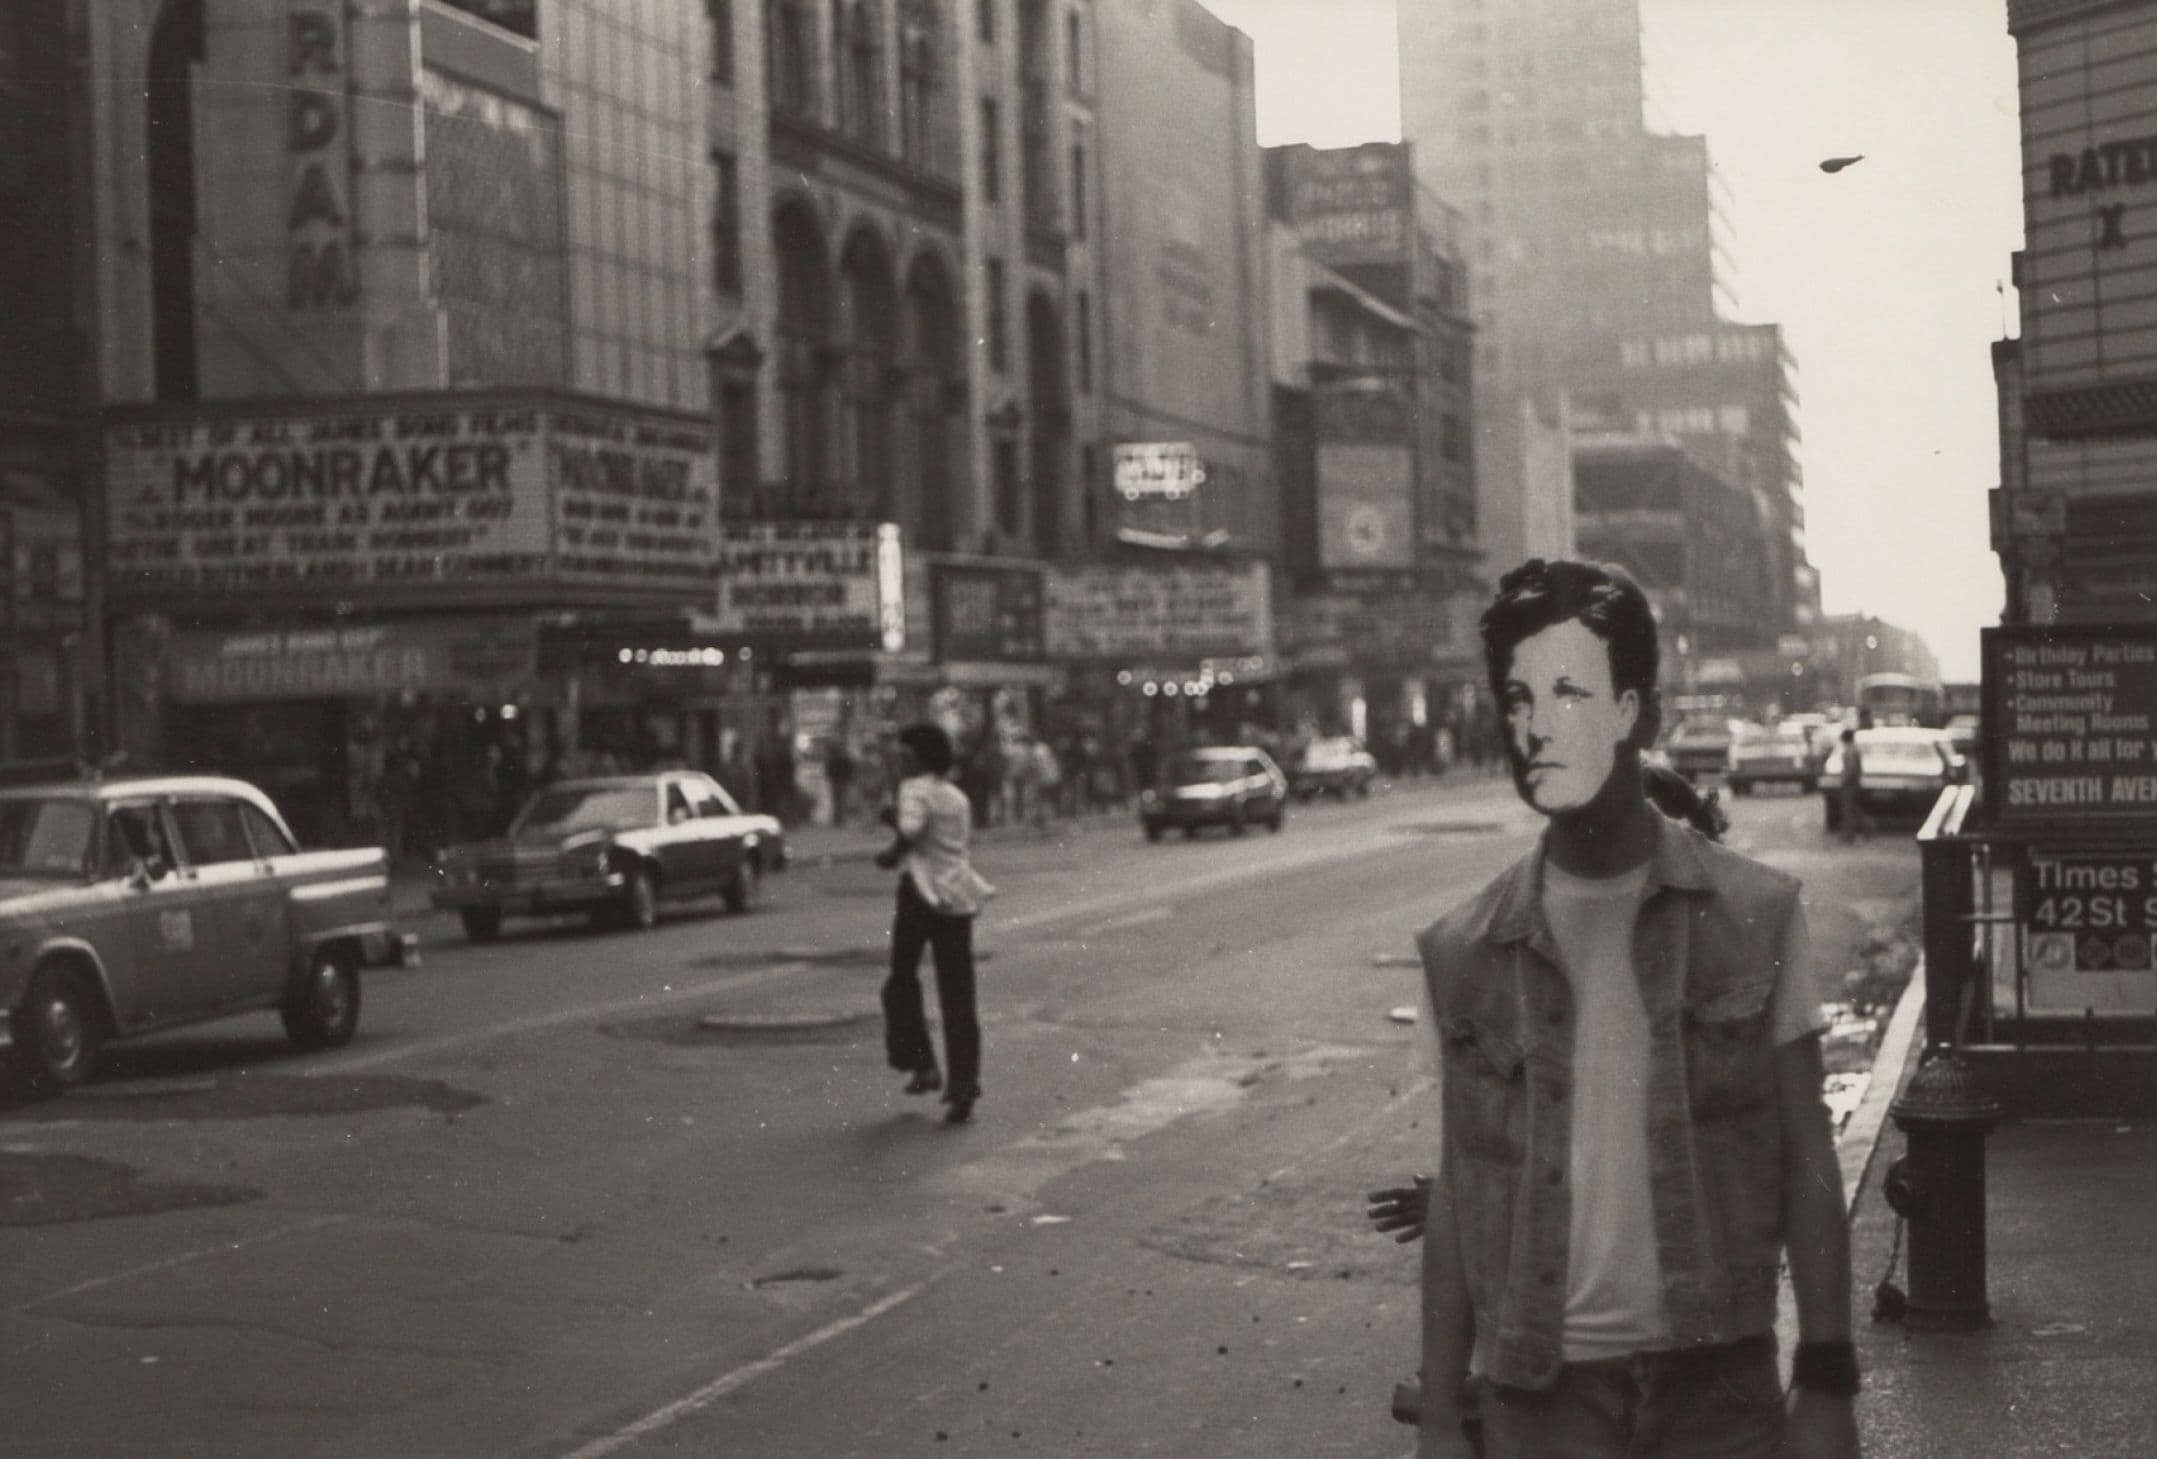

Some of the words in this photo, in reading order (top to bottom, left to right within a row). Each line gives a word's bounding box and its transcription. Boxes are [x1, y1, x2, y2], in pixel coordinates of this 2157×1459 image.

[174, 443, 510, 502] MOONRAKER
[2015, 645, 2087, 666] Birthday
[2092, 643, 2155, 663] Parties
[2016, 669, 2062, 689] Store
[2068, 668, 2115, 688] Tours
[2016, 692, 2113, 712] Community
[2016, 713, 2085, 736] Meeting
[2091, 712, 2149, 731] Rooms
[2008, 739, 2037, 762] We
[2042, 739, 2066, 762] do
[2070, 738, 2083, 761] it
[2088, 738, 2111, 760] all
[2116, 737, 2144, 760] for
[2009, 777, 2102, 805] SEVENTH
[2032, 861, 2139, 889] Times
